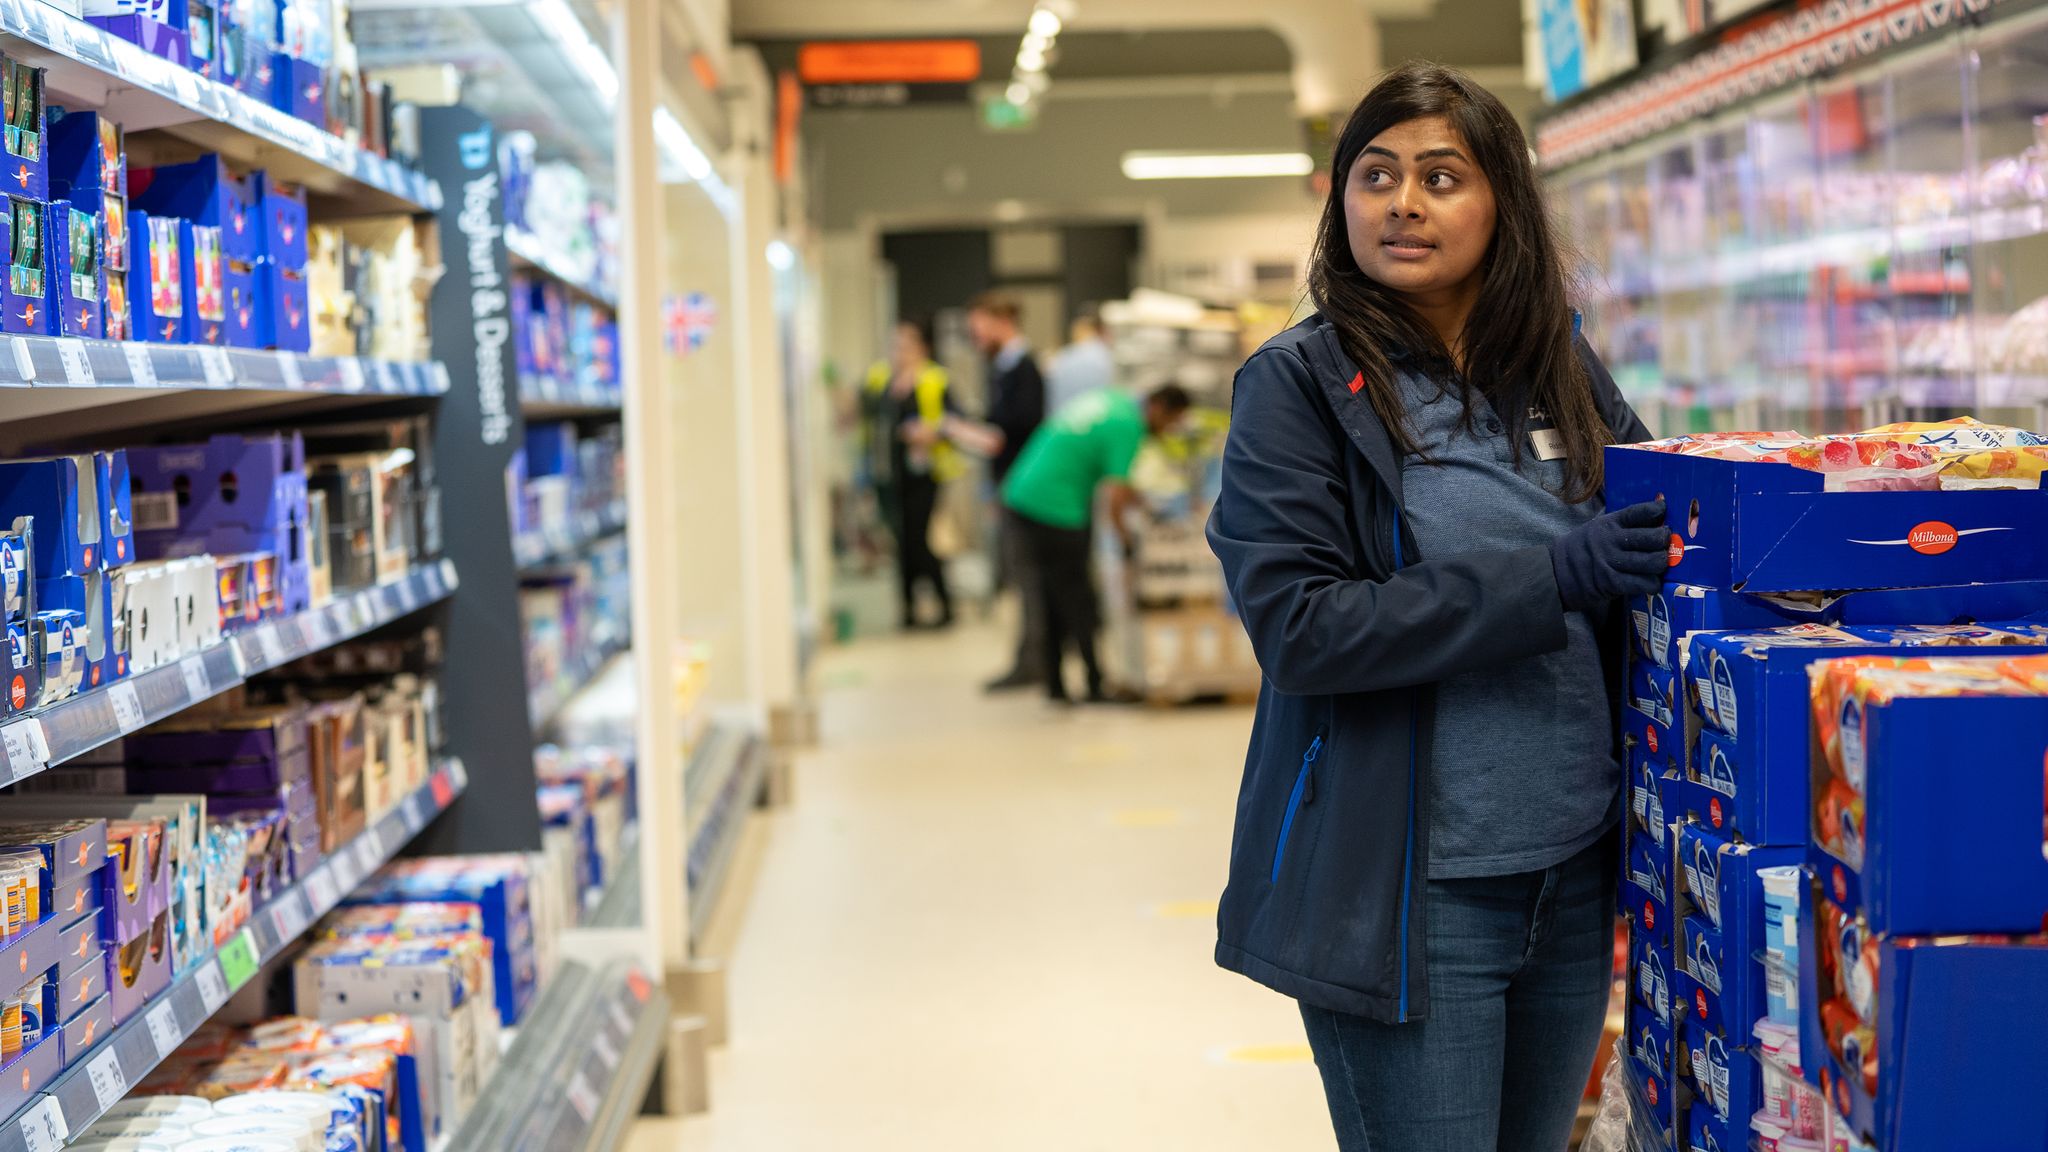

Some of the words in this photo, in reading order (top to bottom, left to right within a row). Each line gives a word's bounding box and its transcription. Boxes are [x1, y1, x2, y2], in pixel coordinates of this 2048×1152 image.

[457, 172, 502, 288] Yoghurt
[471, 289, 506, 317] &
[474, 318, 512, 445] Desserts
[1911, 531, 1954, 543] Milbona
